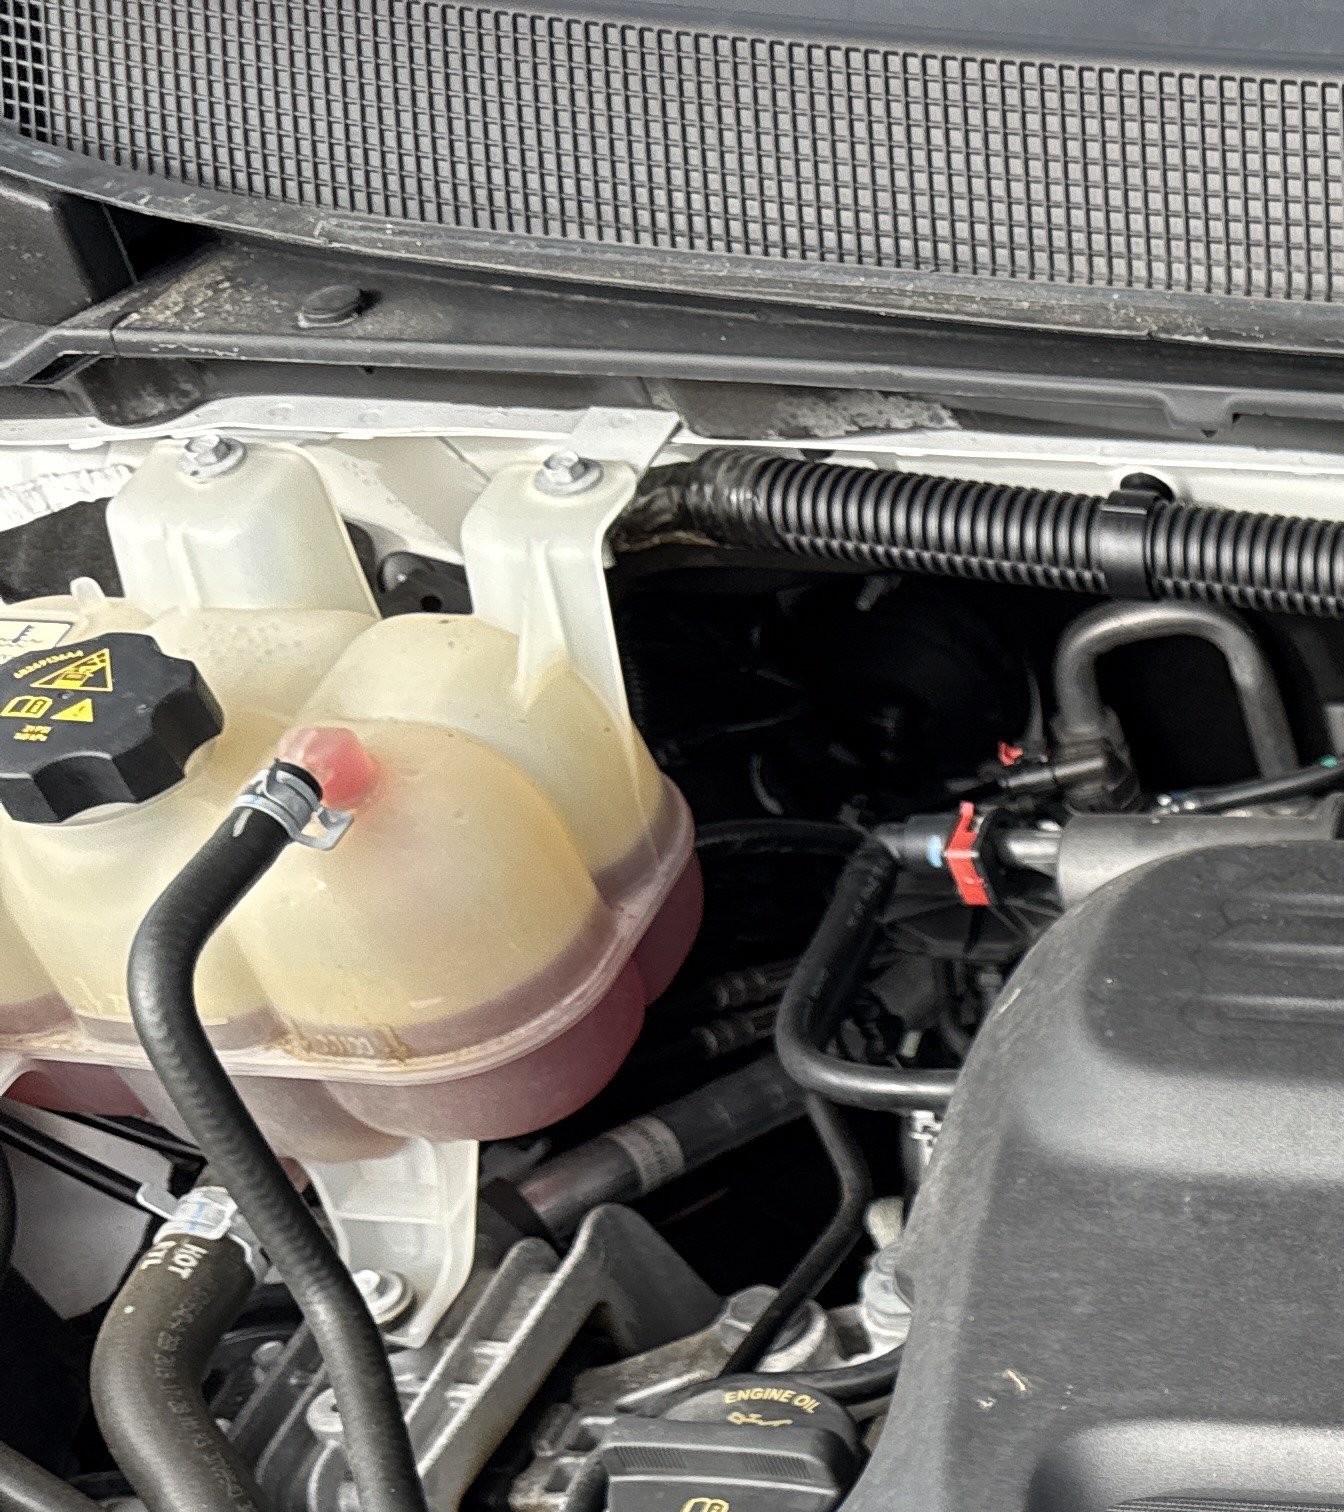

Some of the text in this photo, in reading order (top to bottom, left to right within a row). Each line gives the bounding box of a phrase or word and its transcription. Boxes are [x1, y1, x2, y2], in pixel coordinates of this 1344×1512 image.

[167, 1241, 209, 1280] HOT
[724, 1387, 821, 1415] ENGINE OIL
